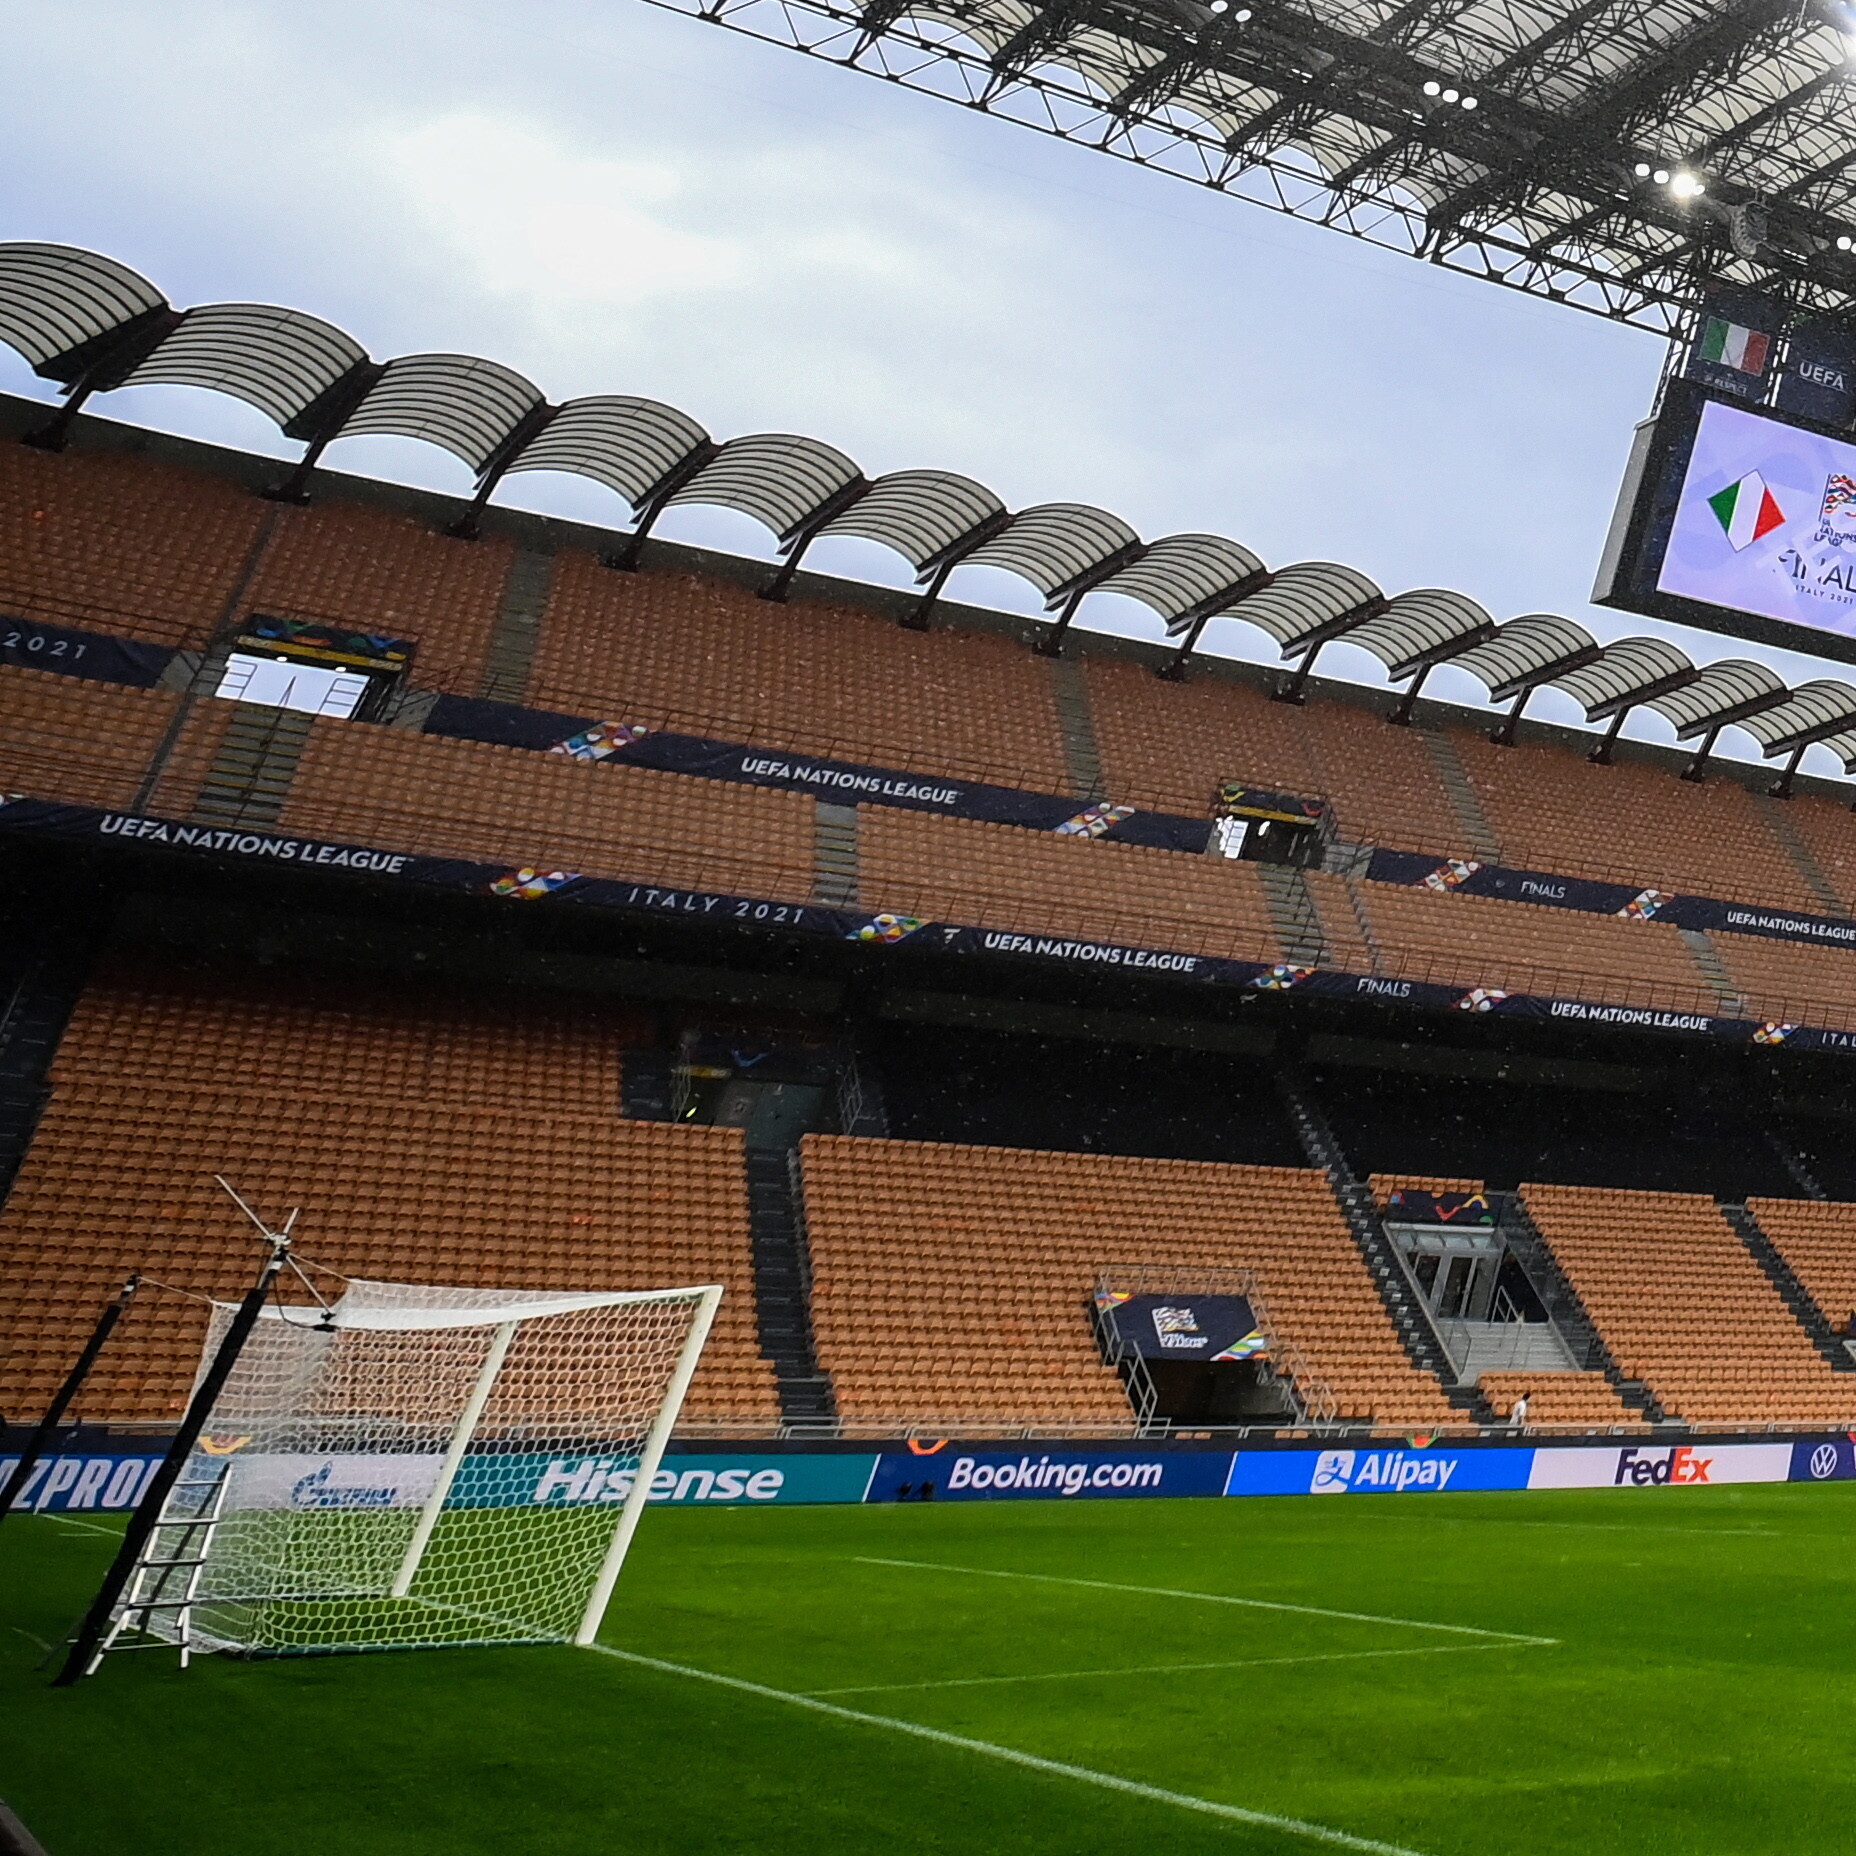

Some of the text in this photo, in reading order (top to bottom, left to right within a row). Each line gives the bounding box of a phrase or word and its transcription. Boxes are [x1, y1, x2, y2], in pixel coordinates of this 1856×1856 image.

[1799, 362, 1844, 390] UEFA
[1795, 584, 1824, 597] ITALY
[4, 631, 87, 659] 2021
[742, 757, 958, 804] UEFA NATIONS LEAGUE
[100, 814, 405, 874] UEFA NATIONS LEAGUE
[629, 888, 803, 924] ITALY 2021
[1520, 881, 1566, 899] FINALS
[1727, 910, 1856, 941] UEFA NATIONS LEAGUE
[984, 932, 1198, 973] UEFA NATIONS LEAGUE
[1357, 978, 1411, 998] FINALS
[1550, 1002, 1709, 1031] UEFA NATIONS LEAGUE
[0, 1458, 166, 1509] ZPRO
[532, 1460, 784, 1501] Hisense
[947, 1455, 1163, 1495] Booking.com
[1354, 1450, 1458, 1492] Alipay
[1614, 1447, 1713, 1486] FedEx
